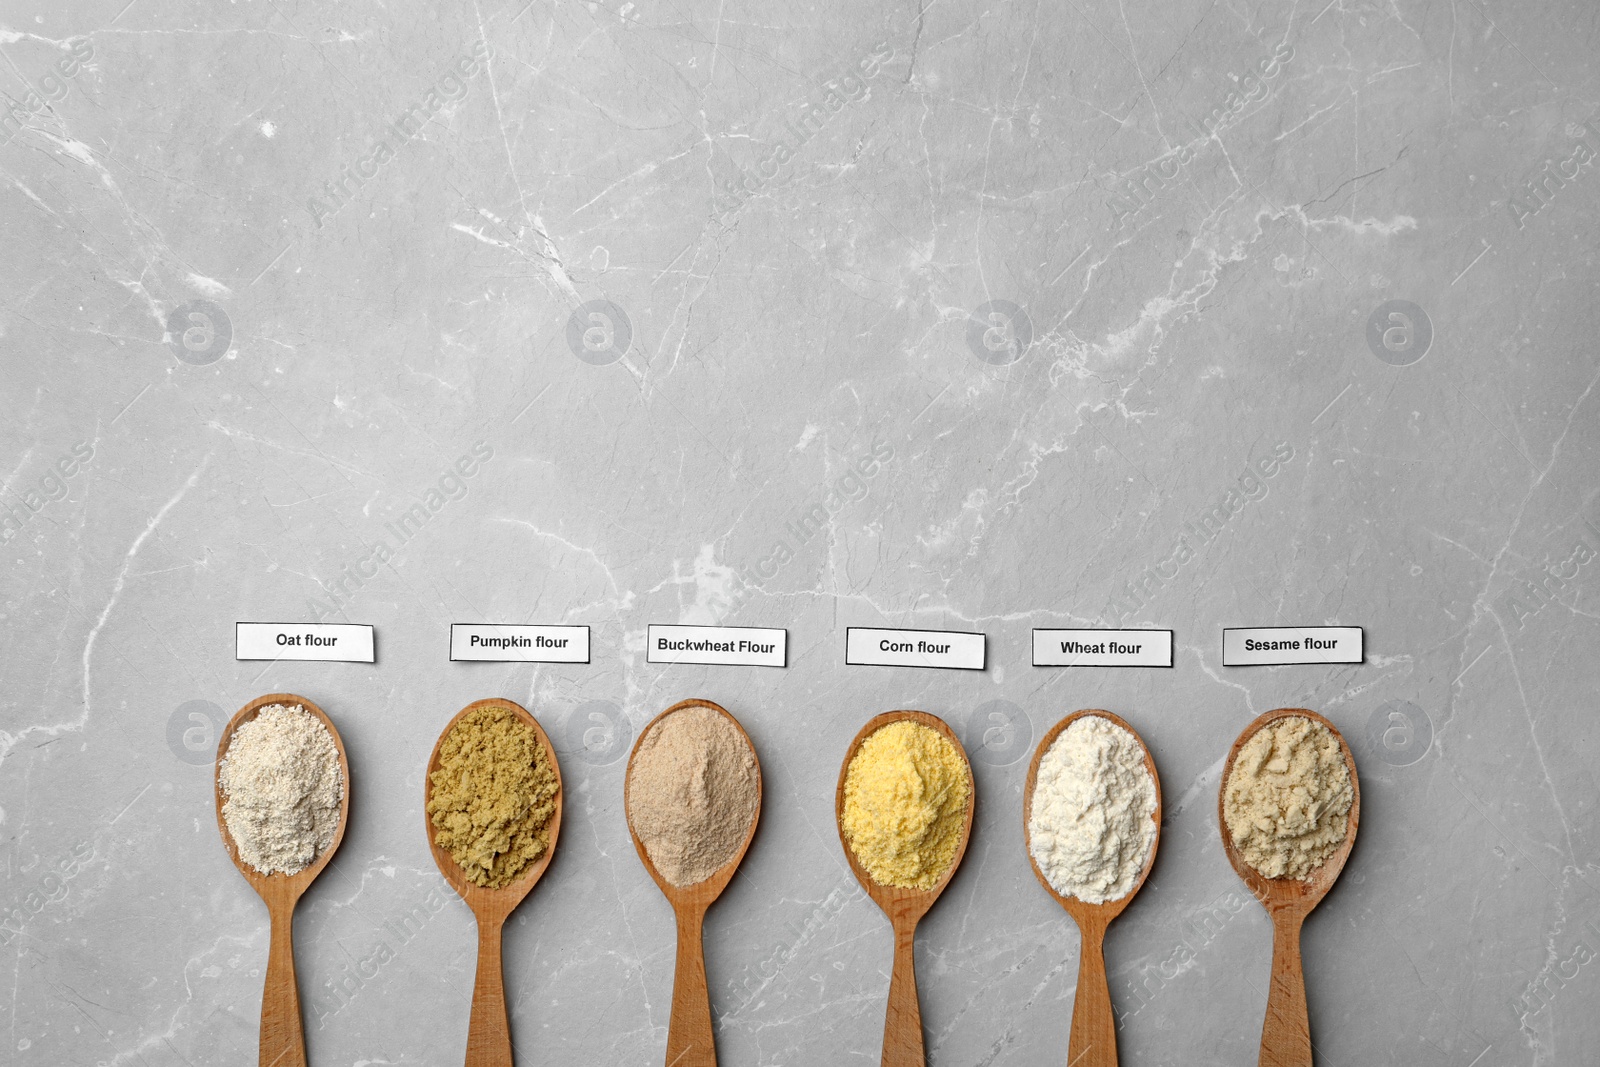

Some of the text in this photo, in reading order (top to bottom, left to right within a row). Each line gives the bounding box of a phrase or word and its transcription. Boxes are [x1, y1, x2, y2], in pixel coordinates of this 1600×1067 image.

[276, 633, 337, 647] Oat flour
[471, 635, 568, 650] Pumpkin flour
[658, 638, 775, 653] Buckwheat Flour
[879, 639, 950, 654] Corn flour
[1244, 637, 1338, 651] Sesame flour
[1060, 642, 1142, 654] Wheat flour
